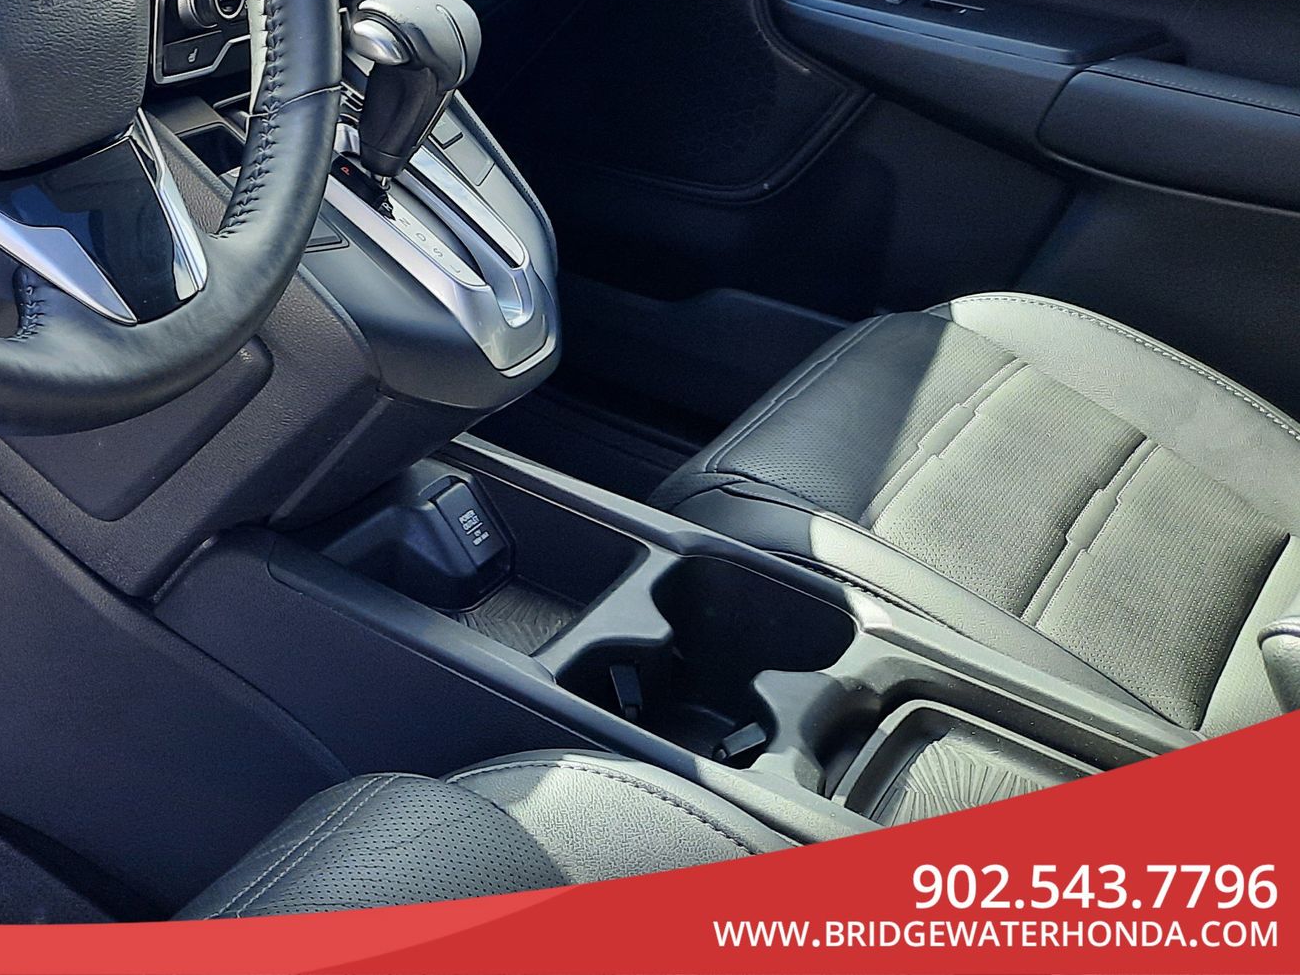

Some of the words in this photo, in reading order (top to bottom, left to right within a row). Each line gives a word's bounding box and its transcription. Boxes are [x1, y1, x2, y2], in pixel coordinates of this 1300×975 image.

[340, 167, 351, 176] P
[382, 202, 393, 212] R
[415, 232, 427, 242] D
[433, 248, 444, 258] S
